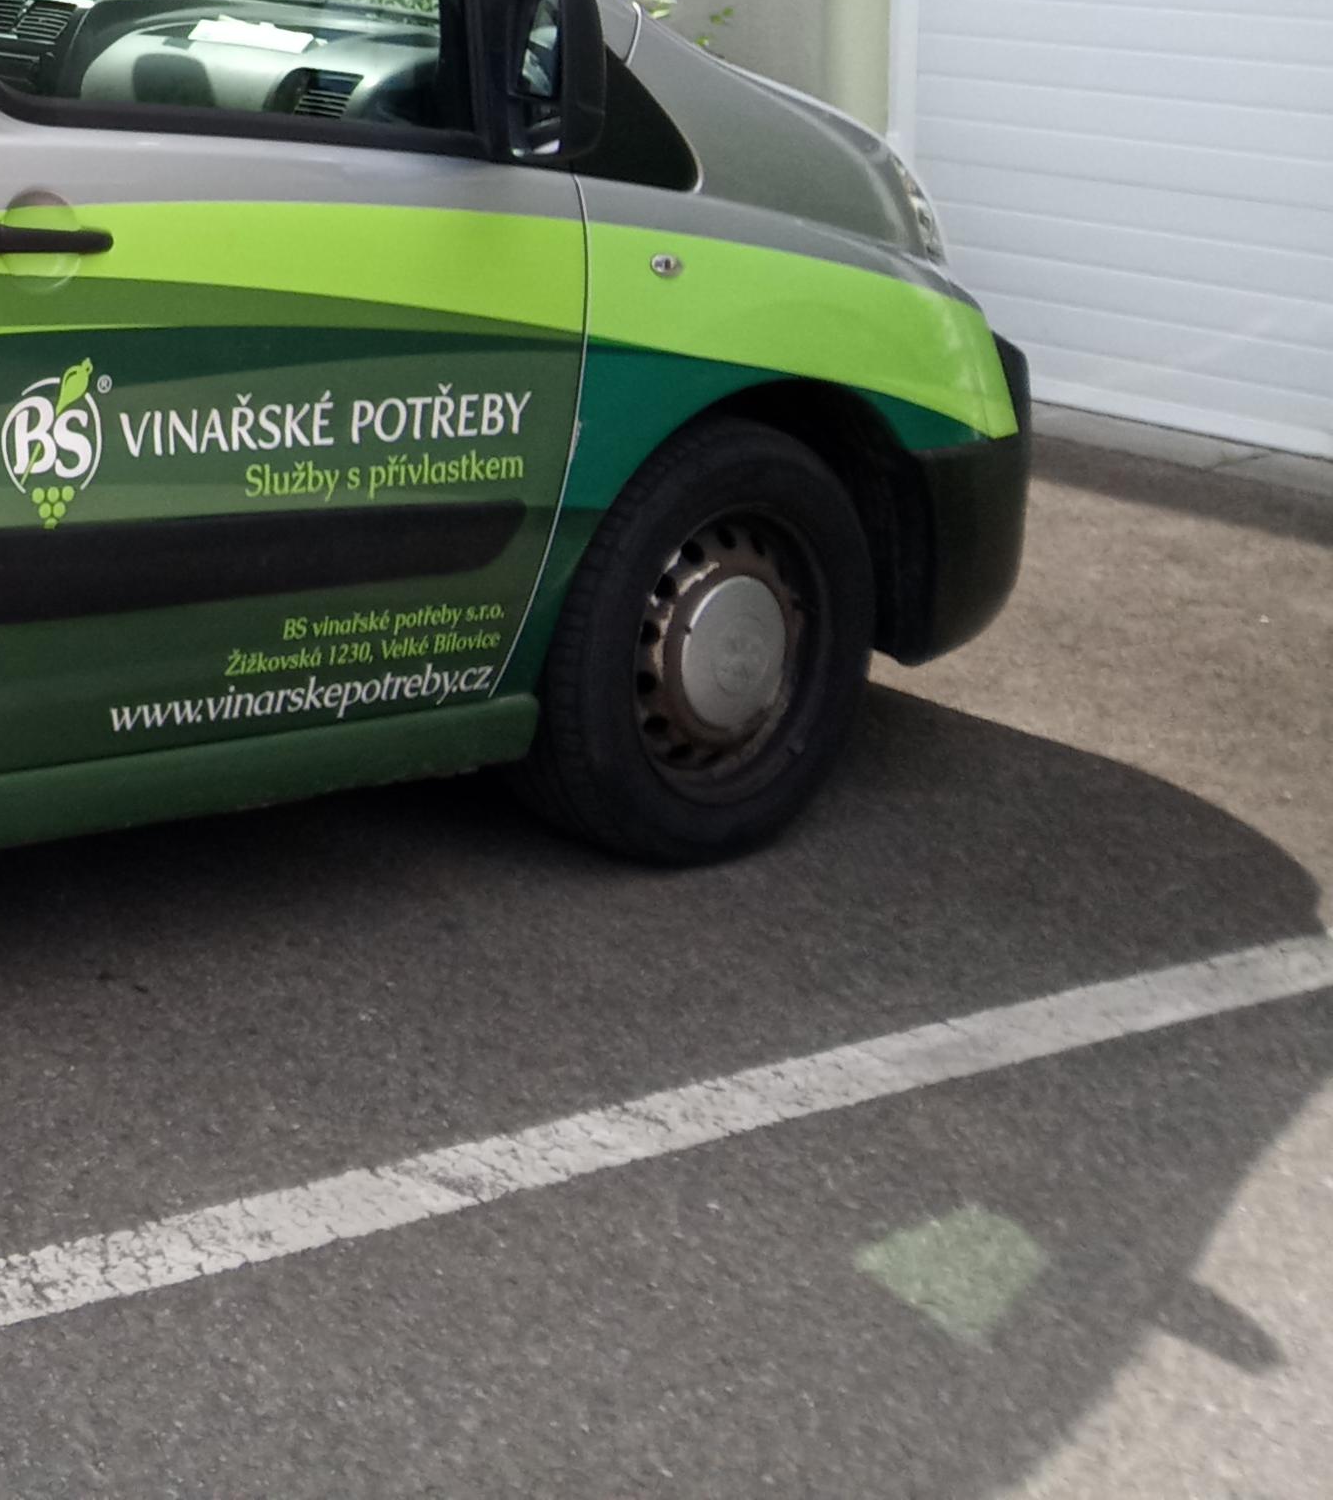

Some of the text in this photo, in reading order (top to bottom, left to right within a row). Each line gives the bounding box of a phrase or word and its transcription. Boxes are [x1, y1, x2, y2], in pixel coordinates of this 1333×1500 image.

[13, 395, 93, 479] BS
[119, 382, 532, 458] VINAŘSKÉ POTŘEBY
[244, 449, 524, 502] Služby s přívlastkem
[283, 603, 505, 641] BS vinařské potřeby s.r.o.
[224, 629, 502, 677] Žižkovská 1230, Velké Bílovice
[109, 662, 495, 732] www.vinarskepotreby.cz
